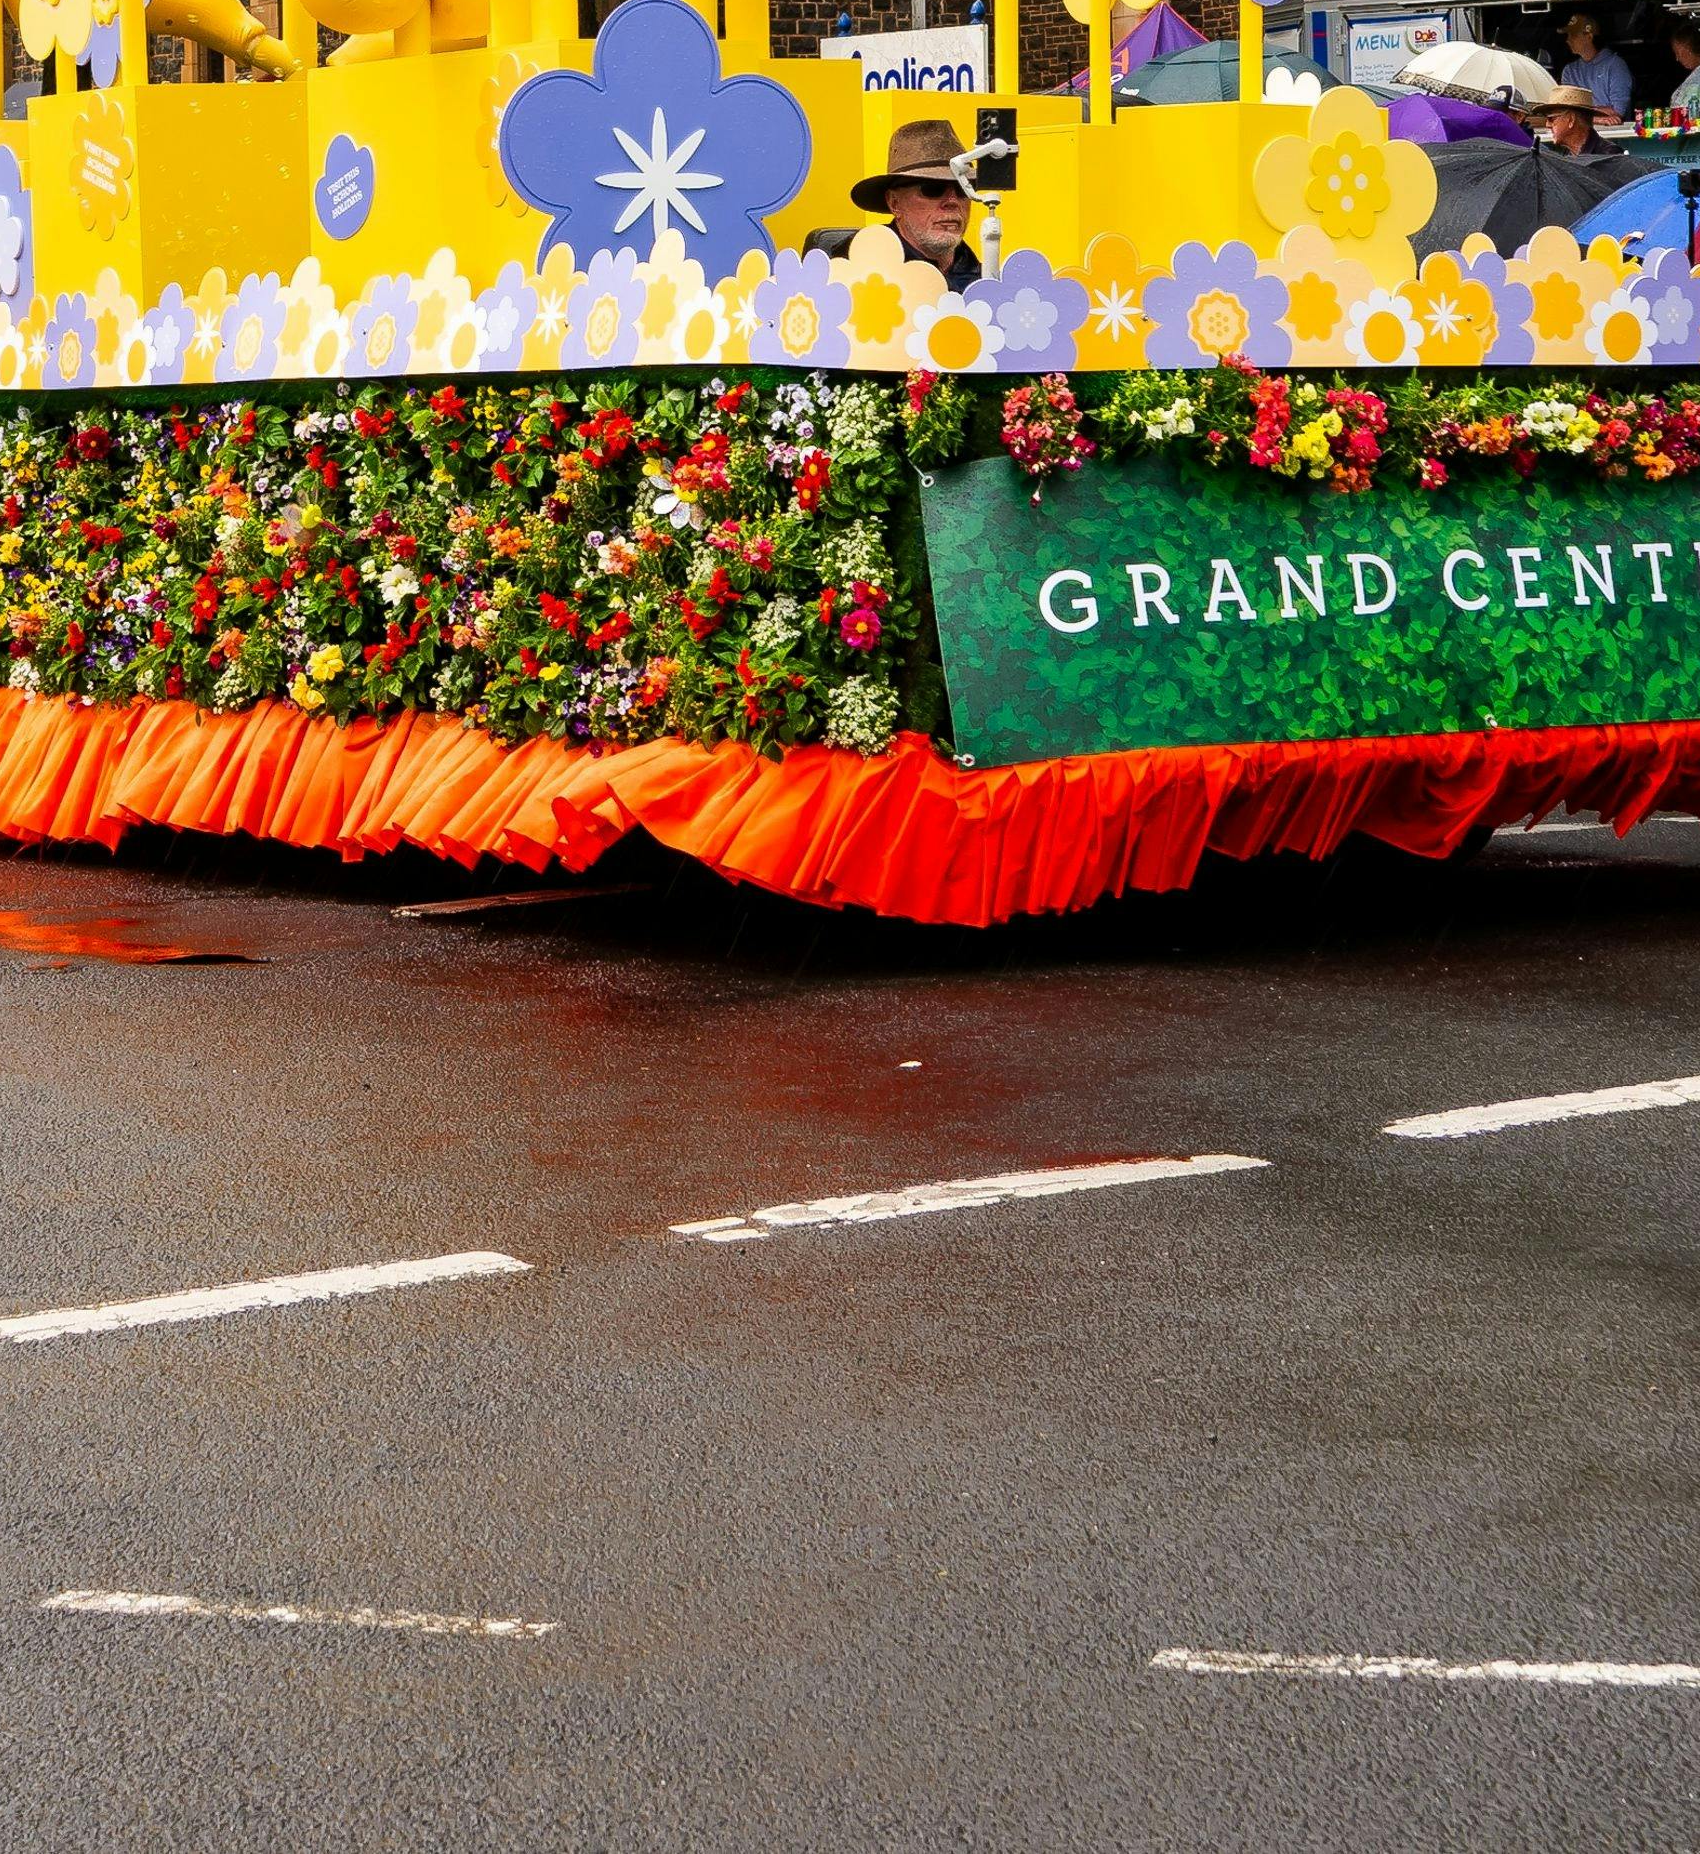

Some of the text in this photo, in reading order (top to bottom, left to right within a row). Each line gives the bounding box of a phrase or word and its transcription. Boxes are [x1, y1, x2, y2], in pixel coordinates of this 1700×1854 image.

[1355, 34, 1400, 51] MENU
[1415, 29, 1437, 40] Dole
[327, 166, 360, 195] VISIT THIS
[333, 181, 358, 205] SCHOOL
[332, 190, 363, 219] HOLIDAYS
[1038, 552, 1397, 634] GRAND
